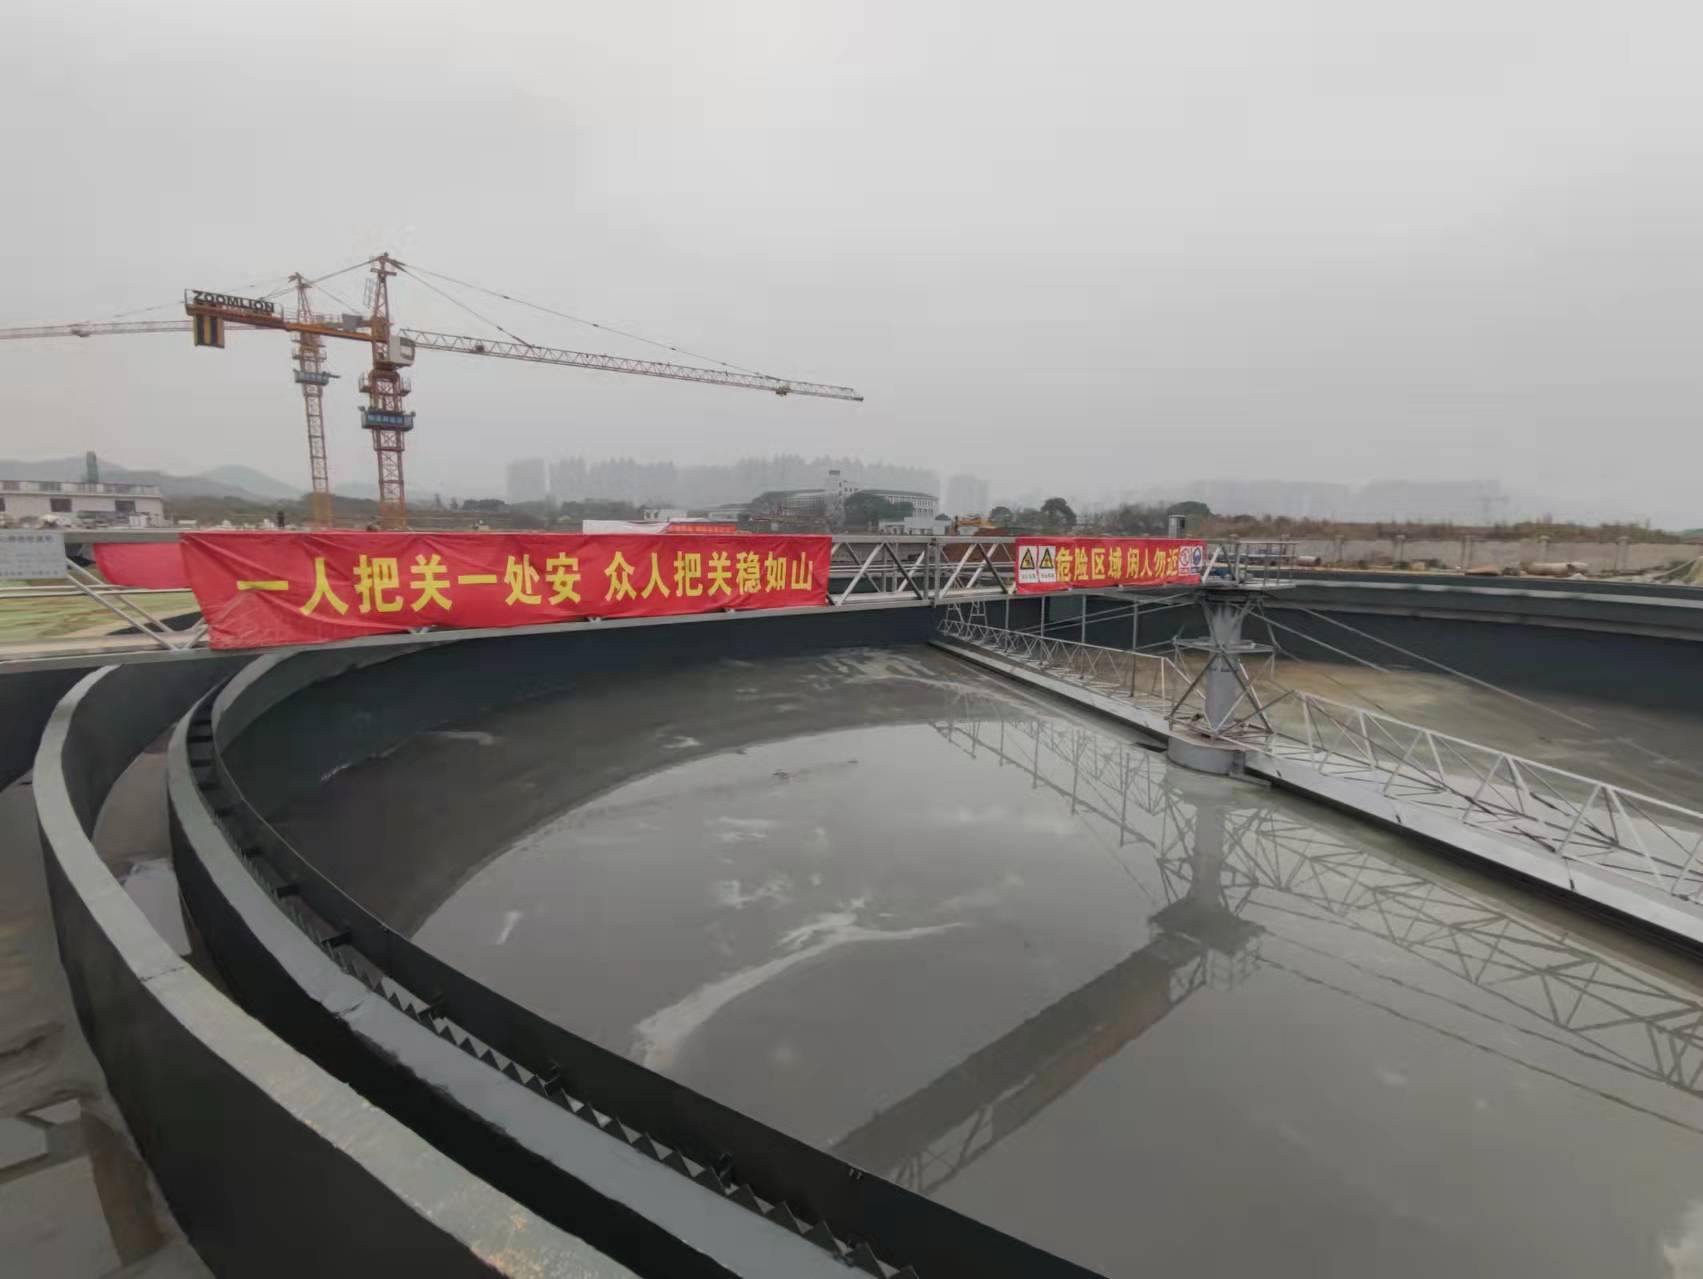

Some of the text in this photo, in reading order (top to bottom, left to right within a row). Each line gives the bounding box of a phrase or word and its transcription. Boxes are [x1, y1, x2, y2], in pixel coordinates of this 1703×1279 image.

[193, 290, 275, 313] ZOOMLION
[237, 551, 812, 615] 一人把关一处安 众人把关稳如山
